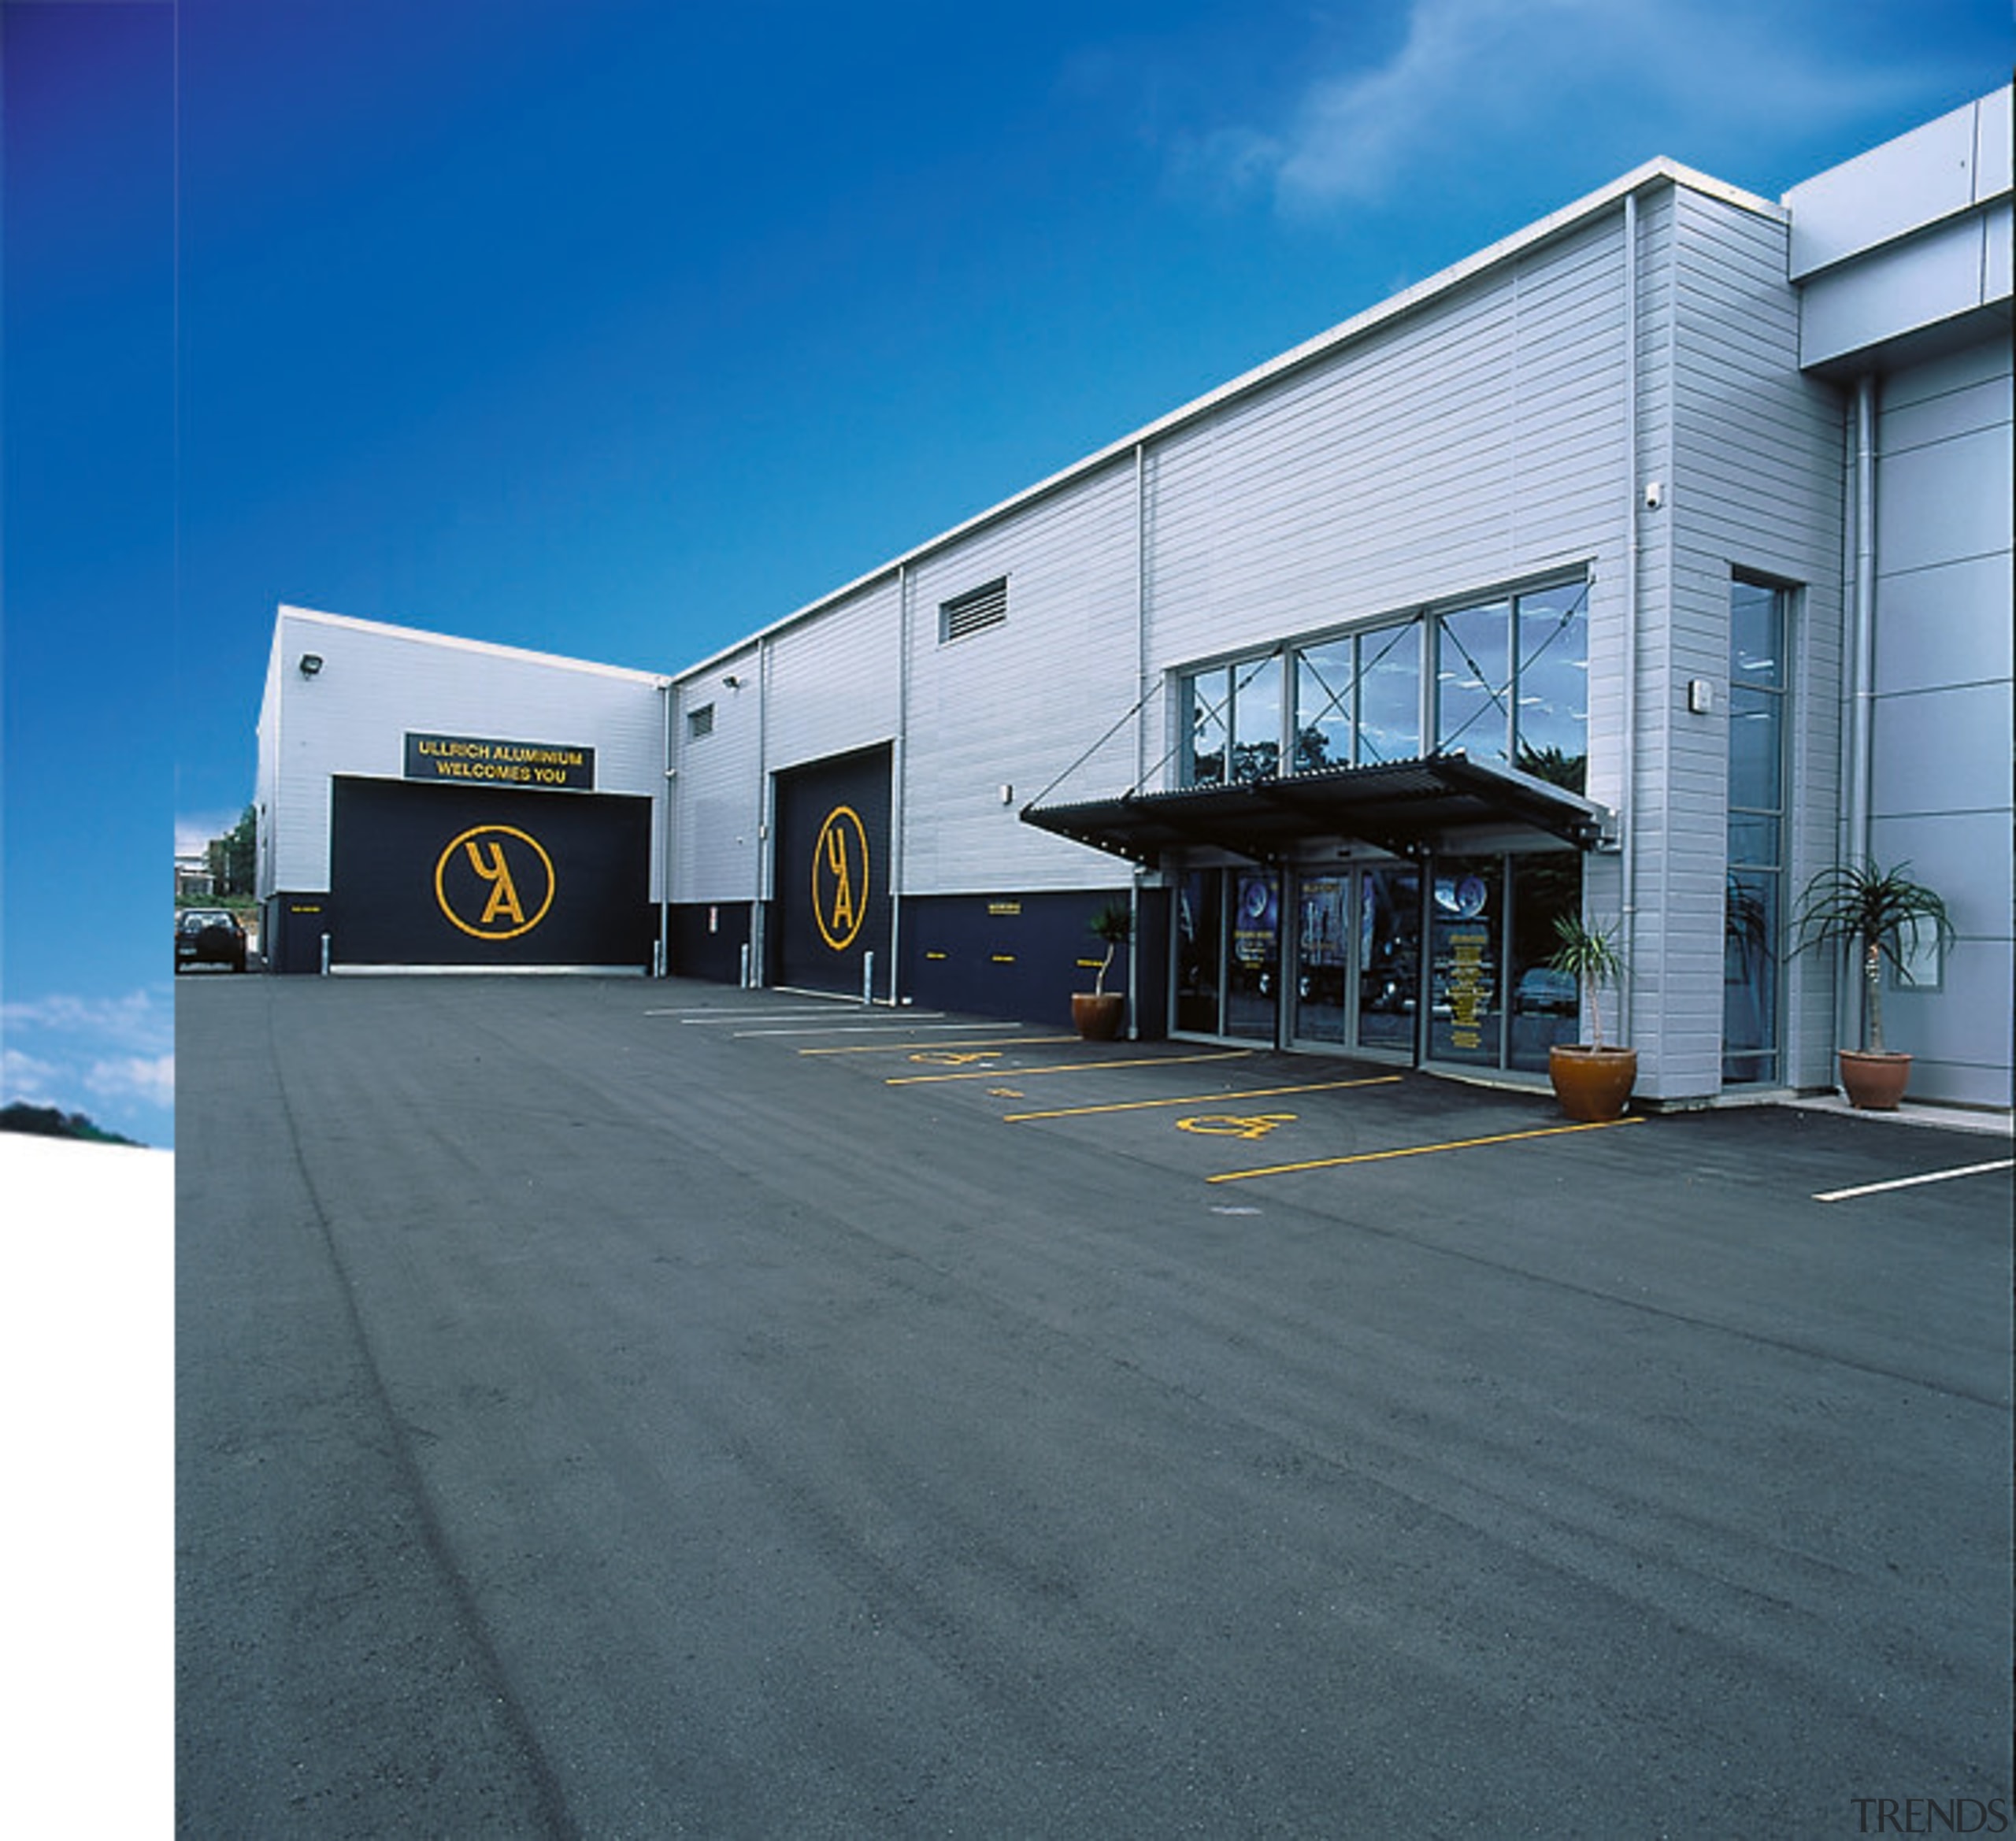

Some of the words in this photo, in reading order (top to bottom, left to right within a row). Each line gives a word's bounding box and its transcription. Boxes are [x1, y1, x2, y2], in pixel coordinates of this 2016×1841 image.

[418, 740, 490, 760] ULLRICH
[493, 746, 583, 765] ALUMINIUM
[435, 761, 531, 782] WELCOMES
[534, 768, 567, 783] YOU
